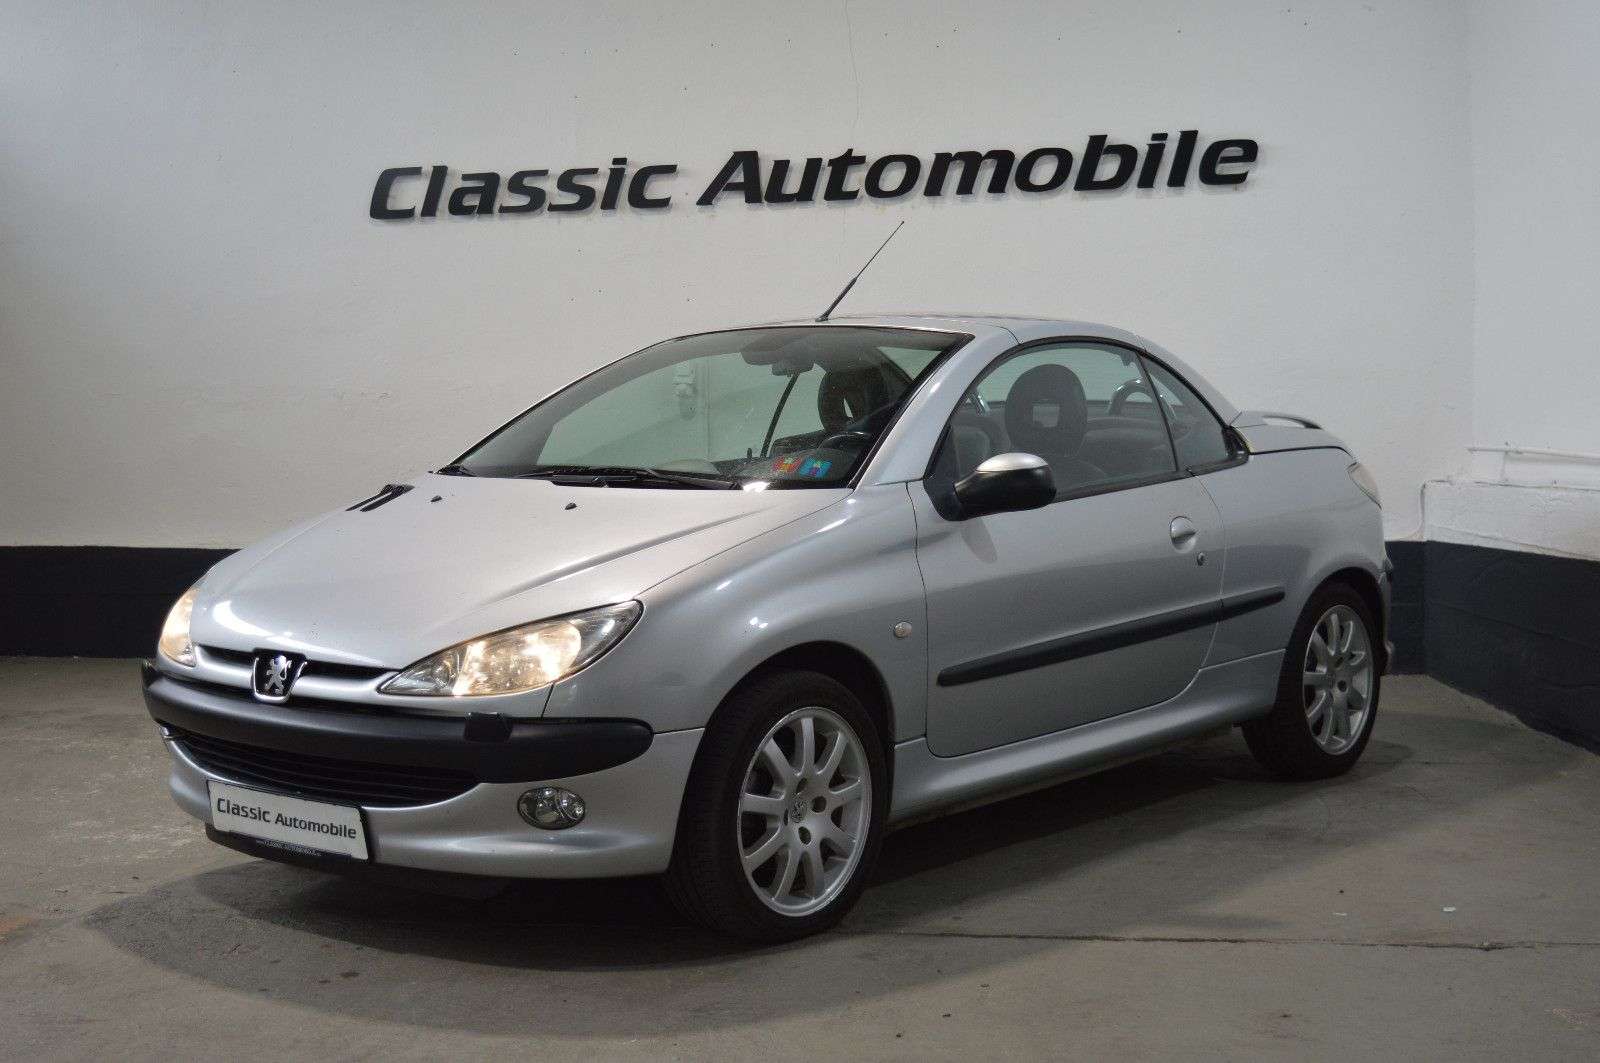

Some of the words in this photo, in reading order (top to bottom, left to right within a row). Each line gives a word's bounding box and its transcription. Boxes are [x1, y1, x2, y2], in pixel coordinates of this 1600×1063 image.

[370, 158, 678, 219] Classic
[696, 130, 1259, 205] Automobile
[217, 798, 271, 823] Classic
[274, 813, 357, 839] Automobile
